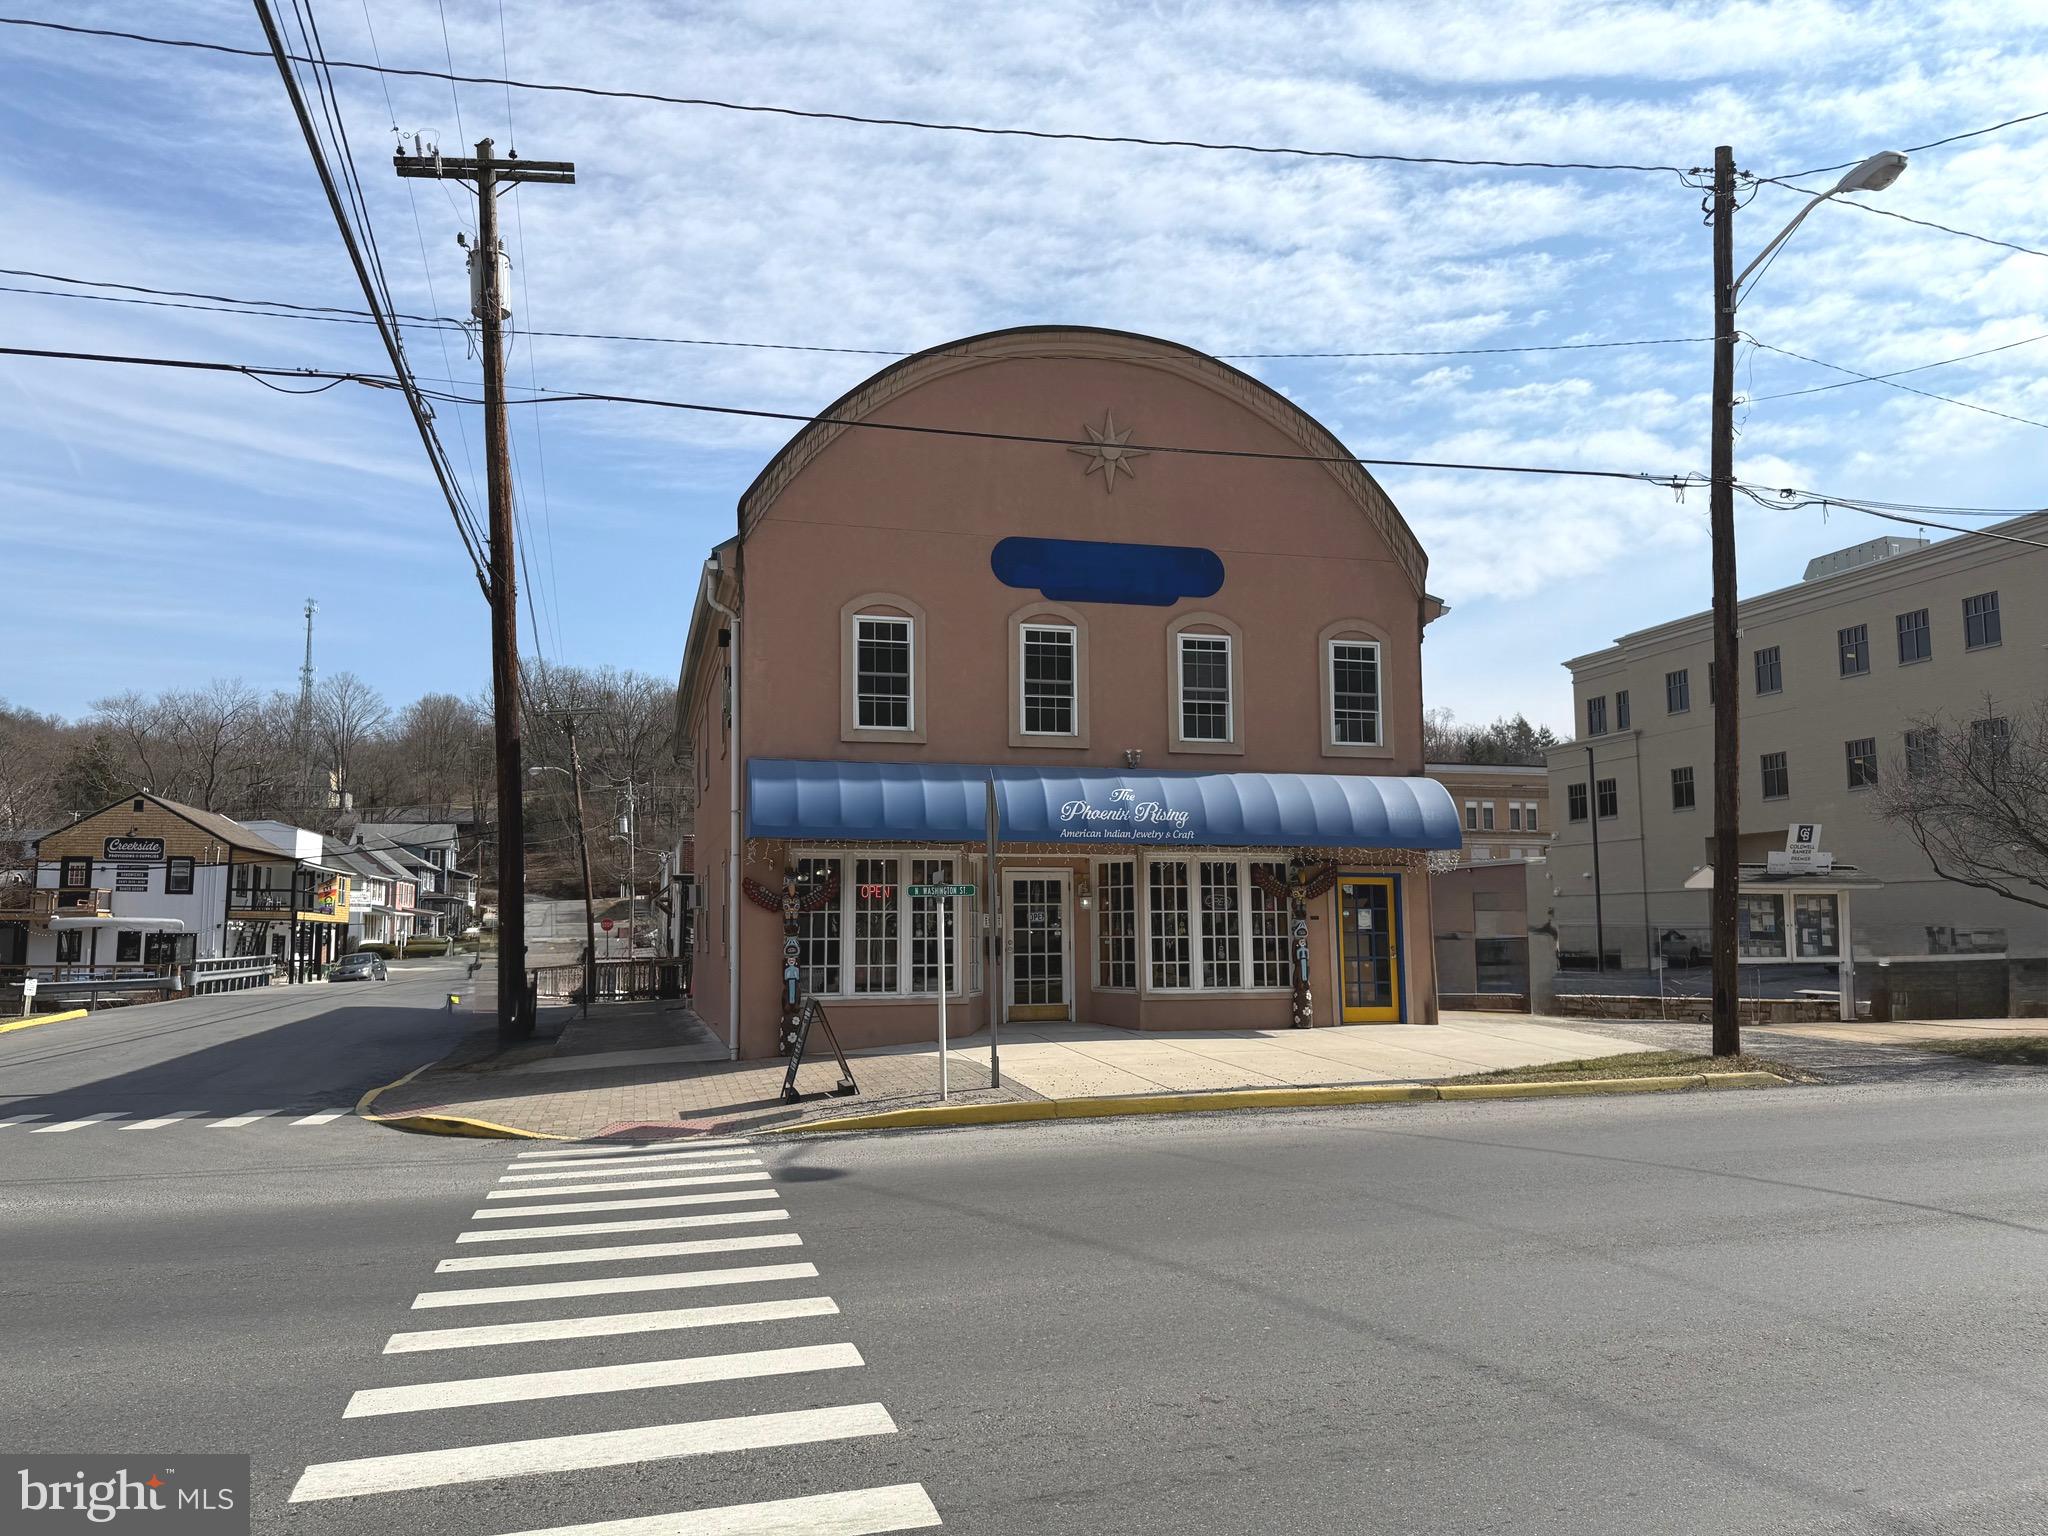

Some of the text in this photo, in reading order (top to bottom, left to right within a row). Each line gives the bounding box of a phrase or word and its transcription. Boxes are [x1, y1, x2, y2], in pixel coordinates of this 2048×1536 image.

[1109, 788, 1136, 803] The
[1060, 800, 1190, 829] Phoenix Rising
[1060, 828, 1102, 839] American
[1104, 829, 1131, 839] Indian
[1131, 829, 1164, 841] Jewelry
[1173, 829, 1195, 840] Craft
[108, 838, 161, 852] Creekside
[861, 884, 891, 899] OPEN
[914, 887, 919, 895] N
[923, 886, 957, 895] WASHINGTON
